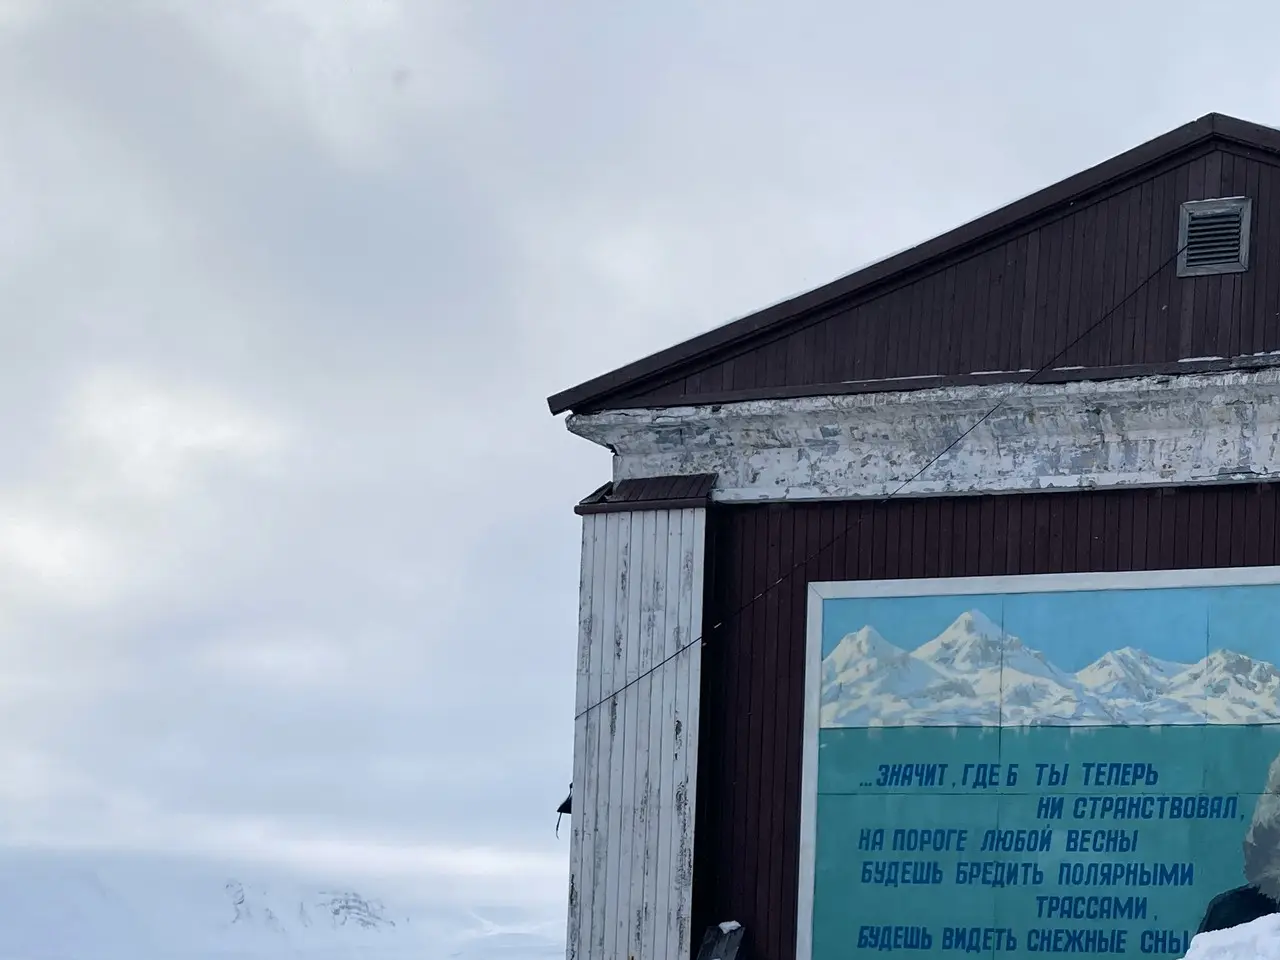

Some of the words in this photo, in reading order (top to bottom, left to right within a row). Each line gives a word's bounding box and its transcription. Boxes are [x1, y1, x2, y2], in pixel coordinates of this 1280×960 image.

[961, 763, 1000, 789] ГДЕ
[1006, 763, 1019, 786] Б
[1035, 763, 1069, 786] ТЫ
[1082, 762, 1159, 786] ТЕПЕРЬ
[1036, 796, 1064, 819] НИ
[1073, 796, 1244, 821] СТРАНСТВОВАЛ,
[858, 828, 884, 851] НА
[892, 828, 968, 851] ПОРОГЕ
[981, 824, 1052, 852] ЛЮБОЙ
[1066, 829, 1139, 852] ВЕСНЫ
[861, 861, 943, 887] БУДЕШЬ
[955, 862, 1043, 888] БРЕДИТЬ
[1058, 862, 1194, 886] ПОЛЯРНЫМИ
[857, 926, 932, 952] БУДЕШЬ
[942, 928, 1017, 954] ВИДЕТЬ
[1027, 929, 1127, 954] СНЕЖНЫЕ
[1140, 930, 1189, 954] СНЫ
